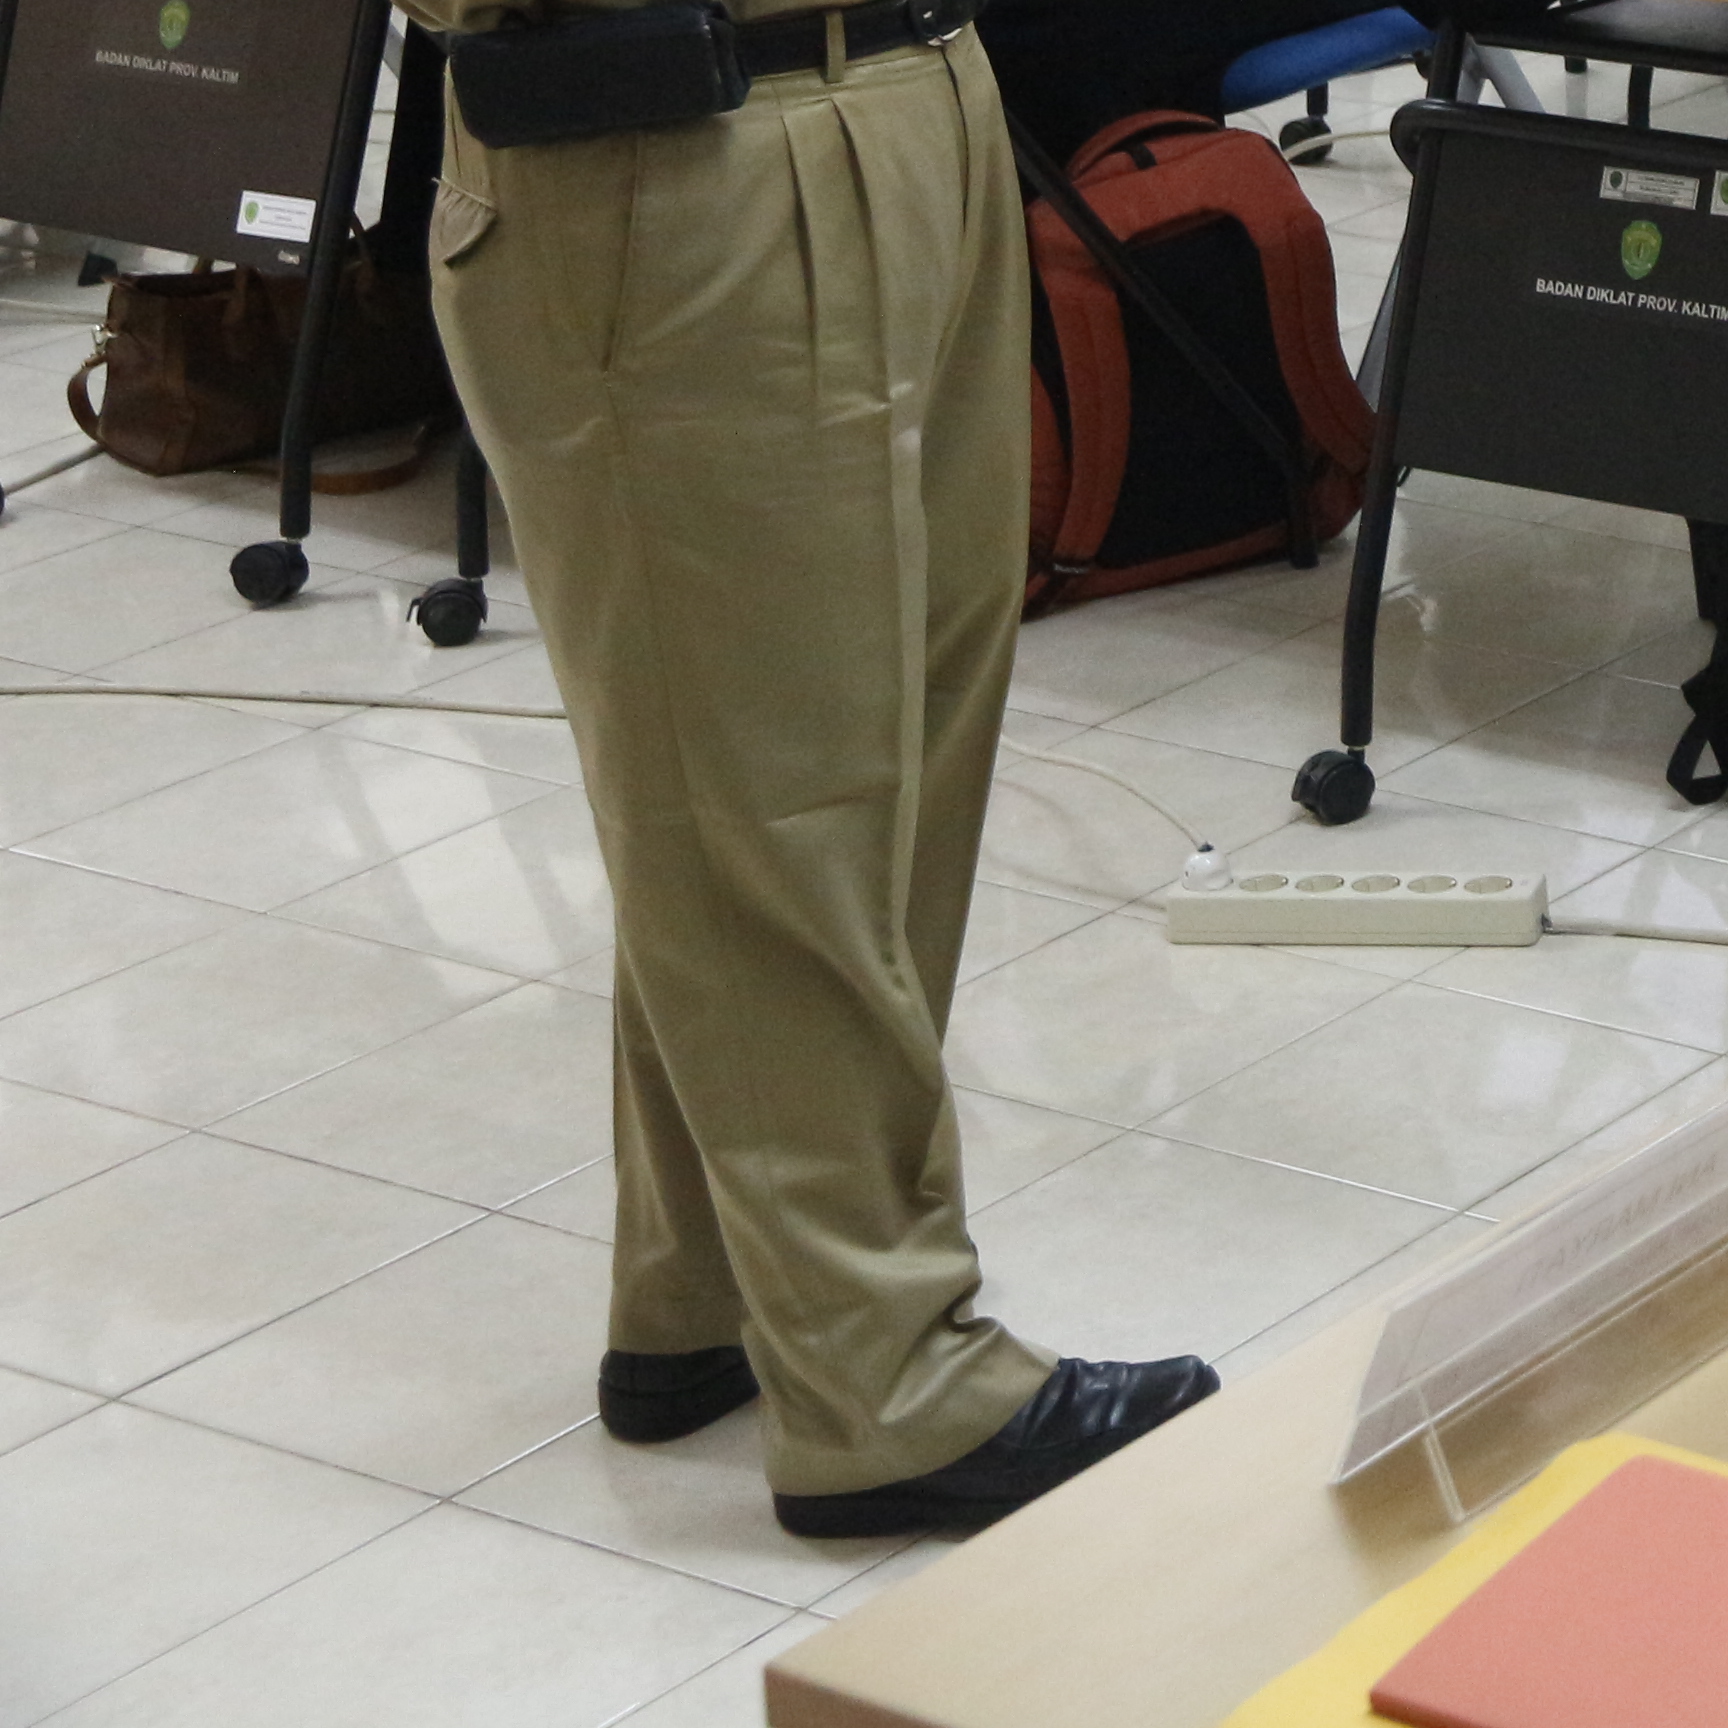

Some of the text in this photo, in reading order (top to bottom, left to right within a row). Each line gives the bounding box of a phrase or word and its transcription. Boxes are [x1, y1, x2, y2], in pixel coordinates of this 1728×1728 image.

[94, 49, 131, 68] BADAN
[131, 55, 167, 73] DIKLAT
[200, 67, 239, 85] KALTIM
[1535, 277, 1584, 300] BADAN
[1586, 285, 1636, 308] DIKLAT
[1637, 292, 1678, 314] PROV.
